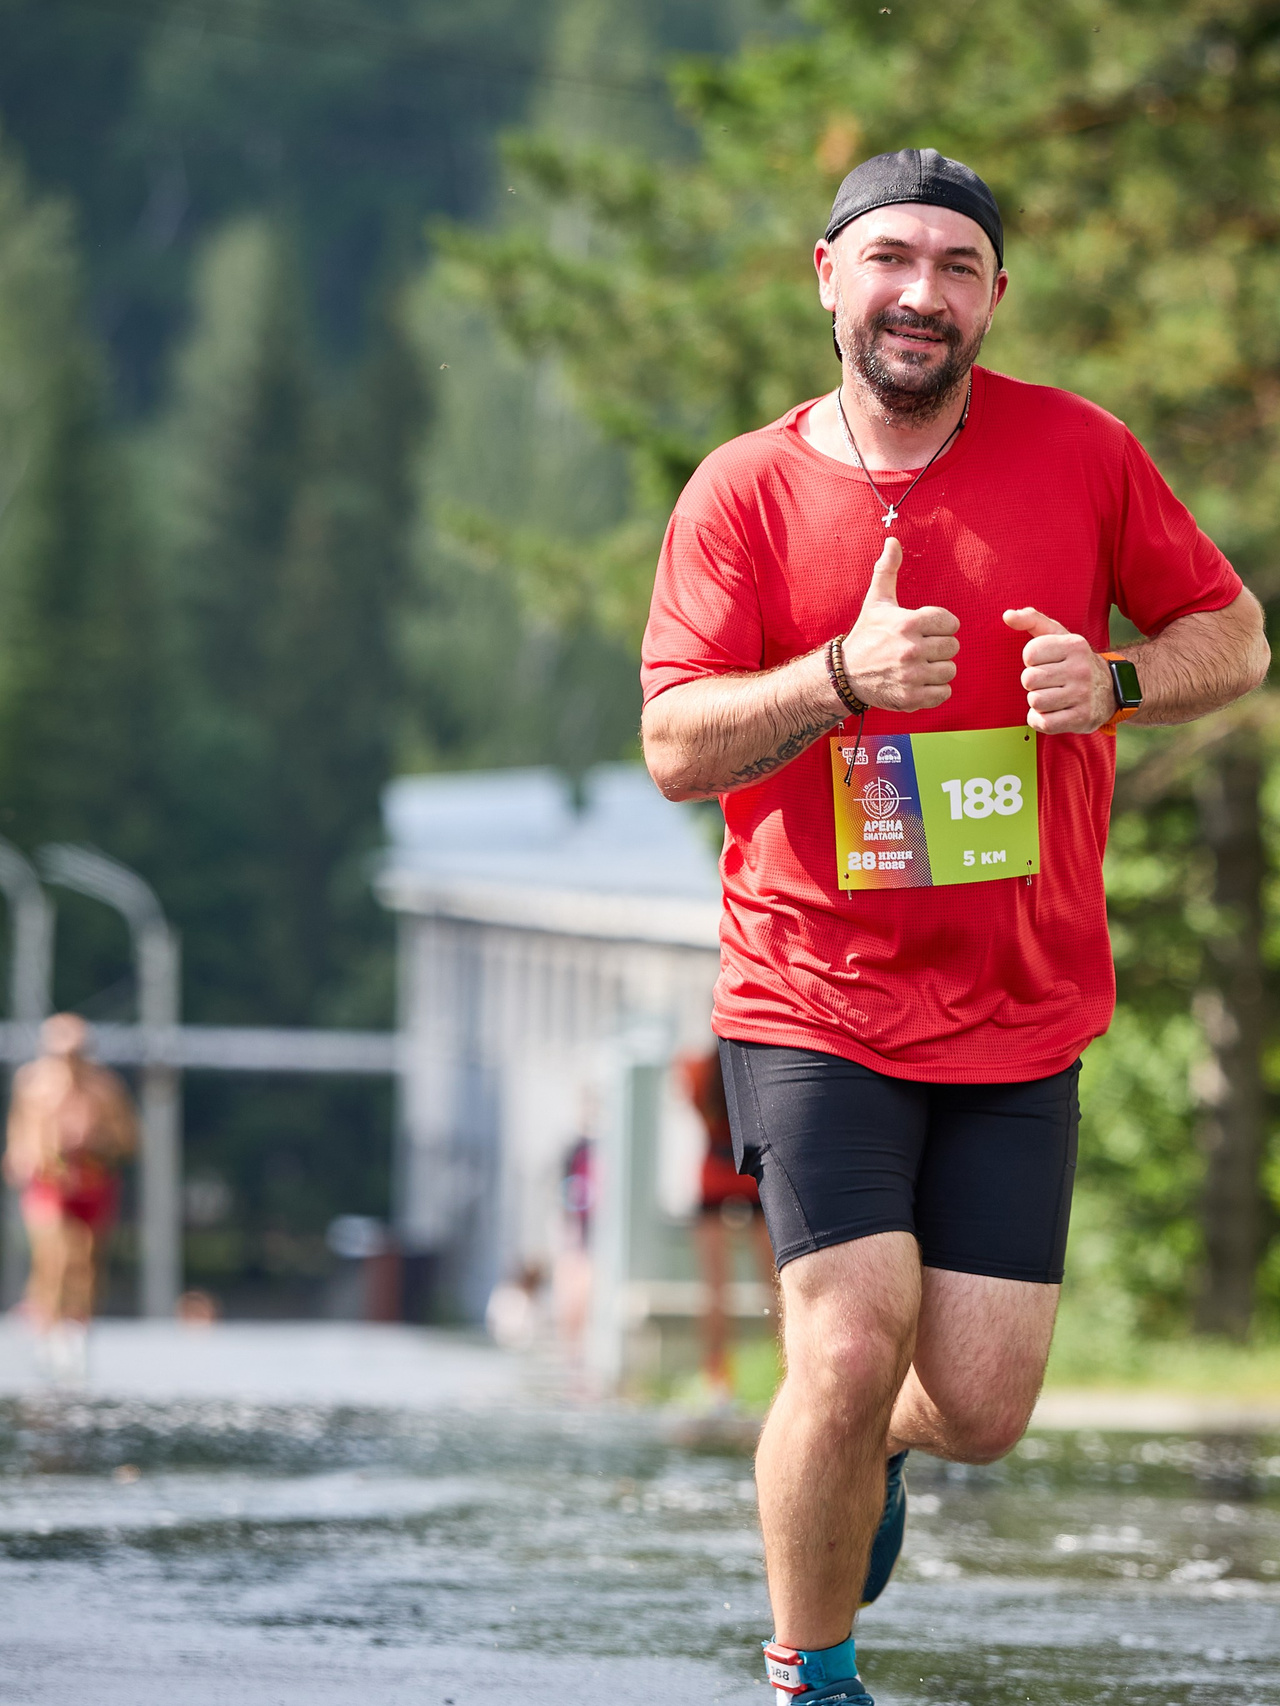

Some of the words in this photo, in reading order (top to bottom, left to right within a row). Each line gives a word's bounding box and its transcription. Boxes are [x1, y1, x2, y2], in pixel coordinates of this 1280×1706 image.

[940, 774, 1024, 820] 188
[863, 820, 903, 832] АРЕНА
[863, 831, 904, 841] БИАТЛОНА
[847, 851, 877, 870] 28
[962, 850, 976, 867] 5
[771, 1665, 790, 1681] 188
